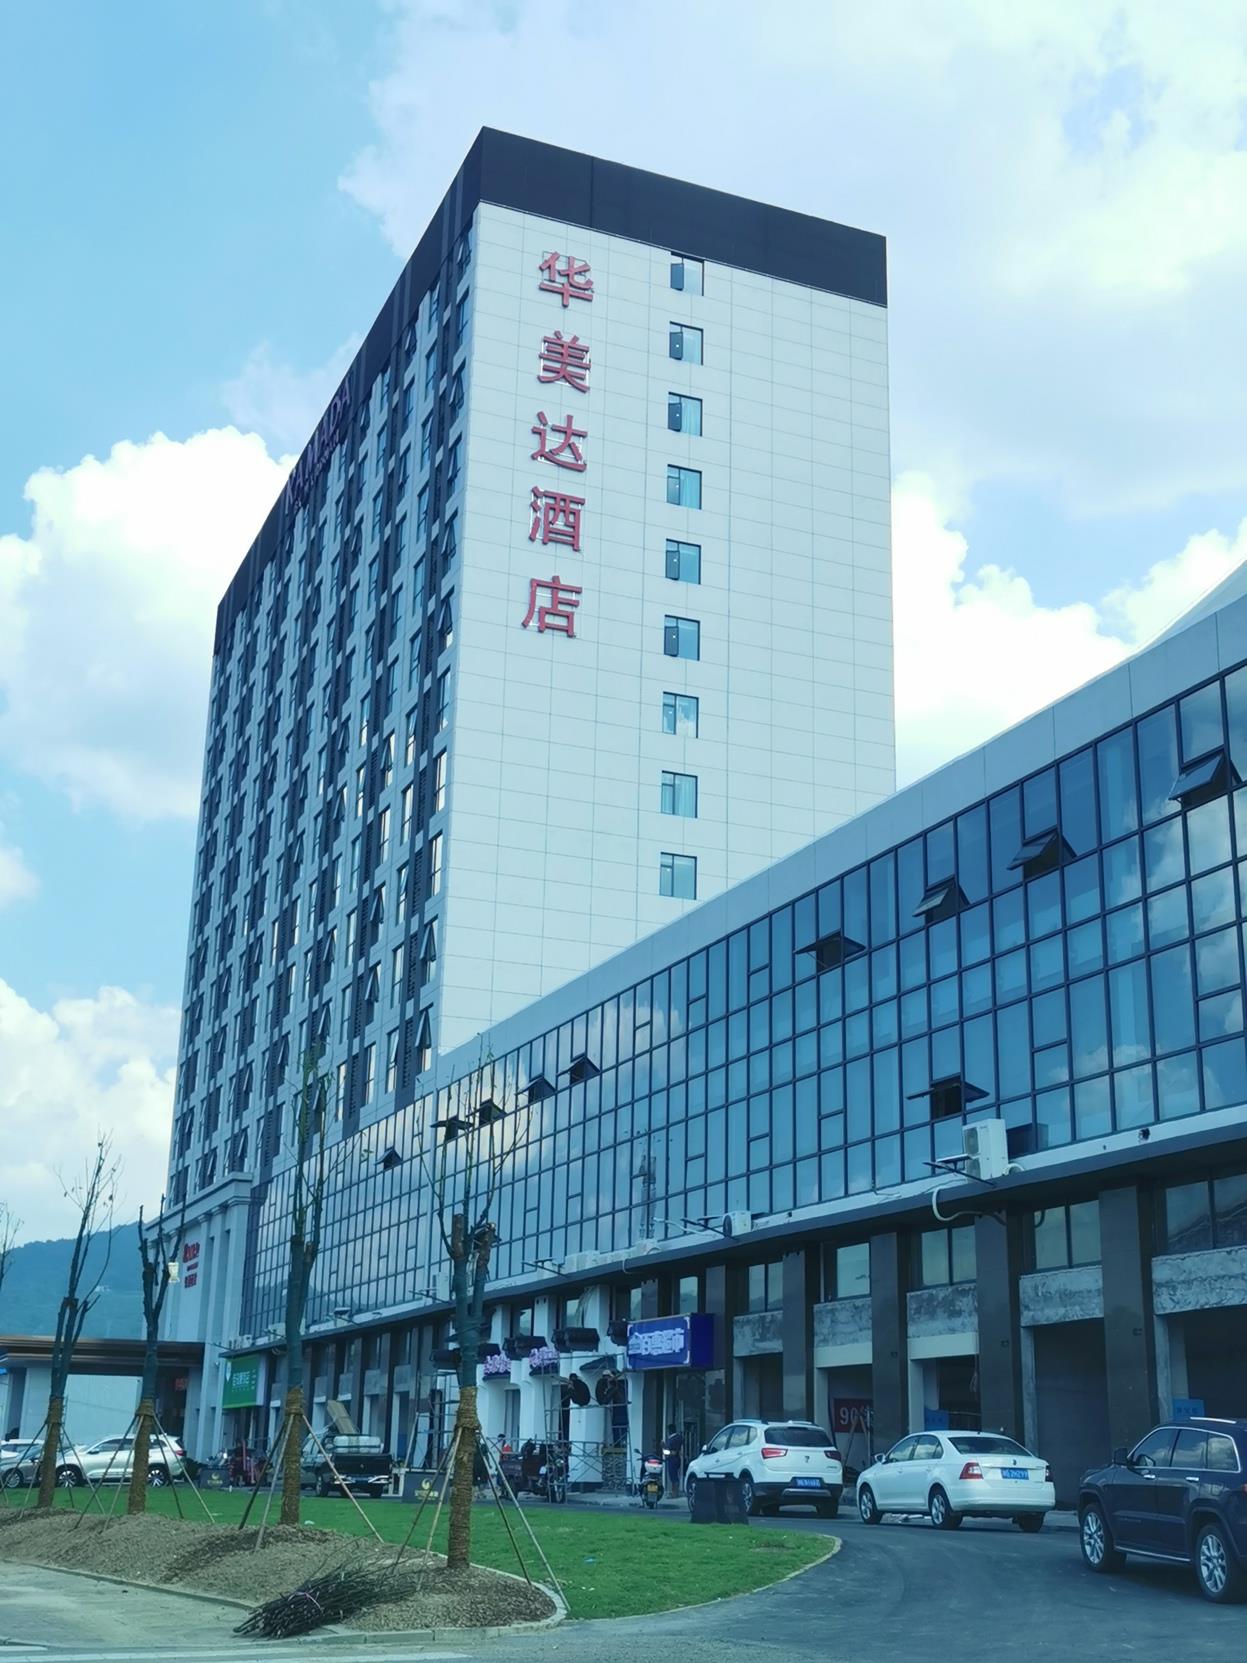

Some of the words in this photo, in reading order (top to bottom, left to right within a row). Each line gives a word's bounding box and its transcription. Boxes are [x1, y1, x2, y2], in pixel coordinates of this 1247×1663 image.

[522, 251, 594, 638] 华美达酒店
